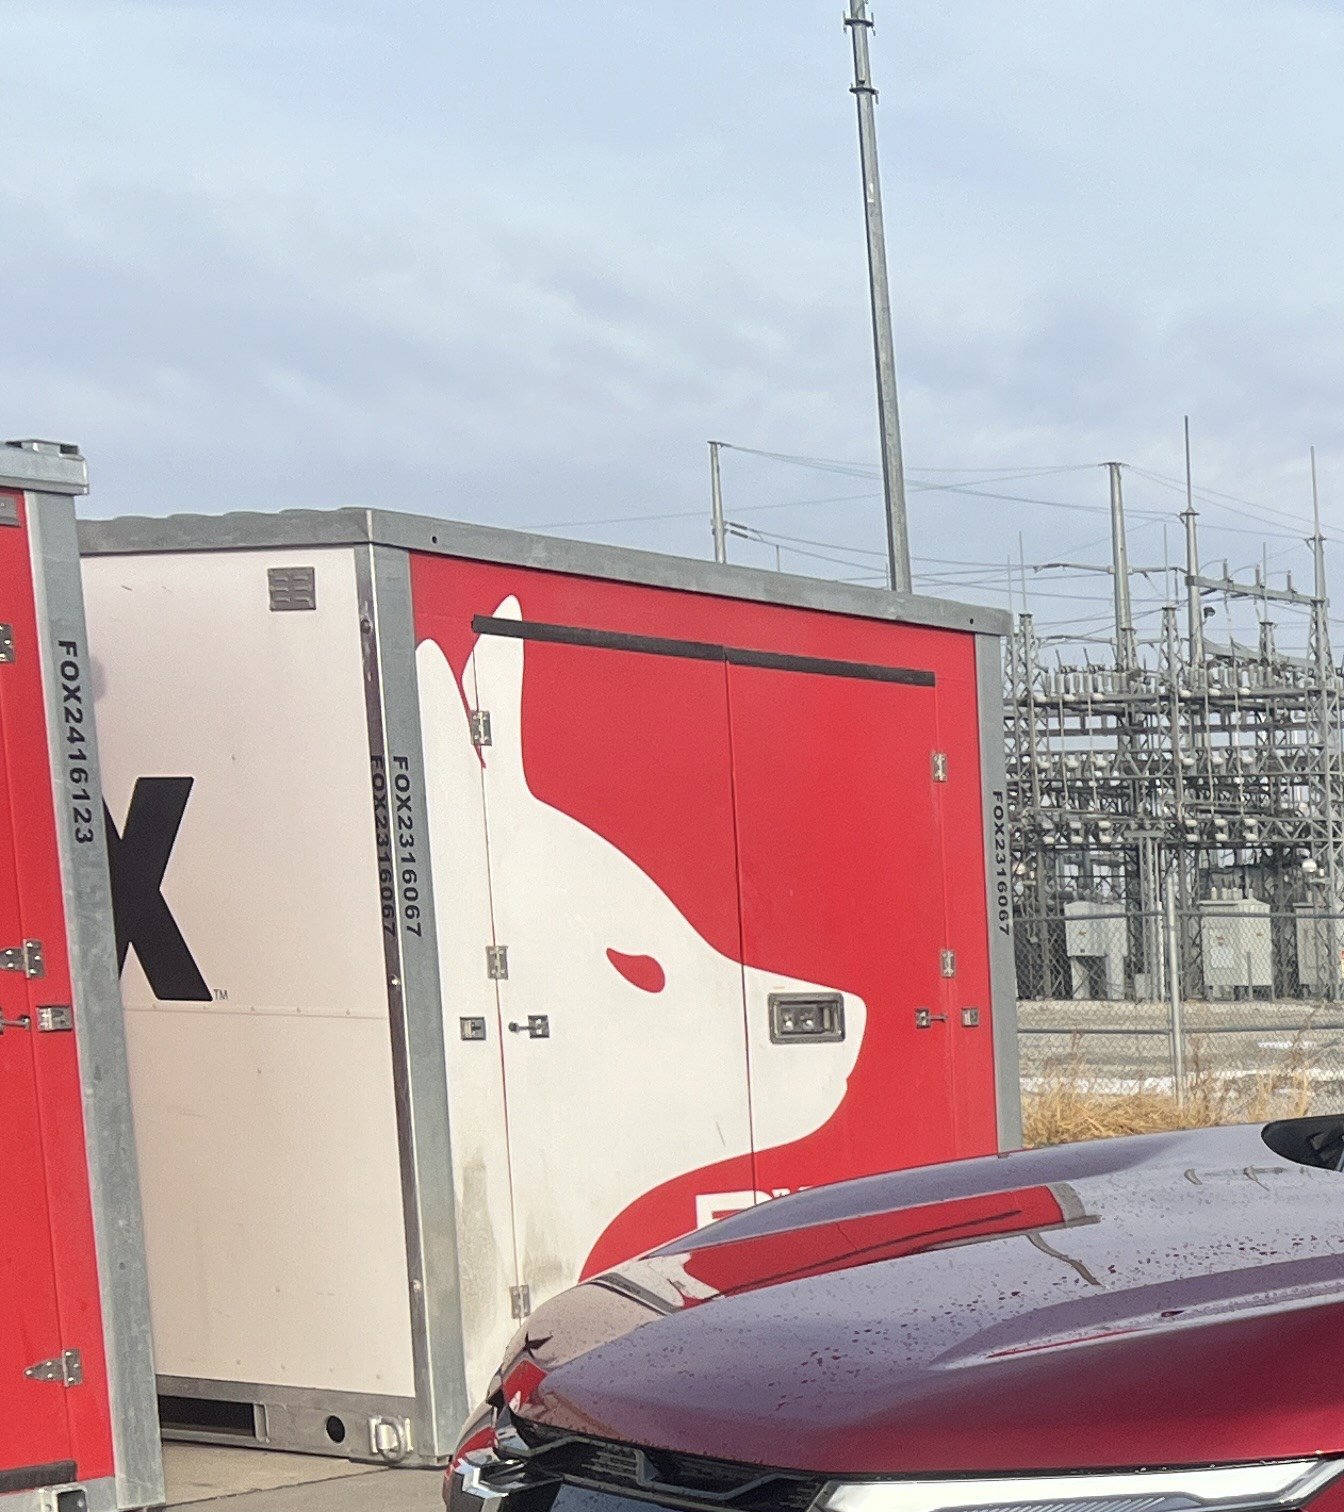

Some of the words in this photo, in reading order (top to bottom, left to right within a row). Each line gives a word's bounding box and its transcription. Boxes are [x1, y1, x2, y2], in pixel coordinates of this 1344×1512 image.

[57, 640, 94, 844] FOX2416123
[370, 754, 397, 937] FOX2316067
[393, 755, 422, 938] FOX2316067
[992, 790, 1010, 936] FOX2316067
